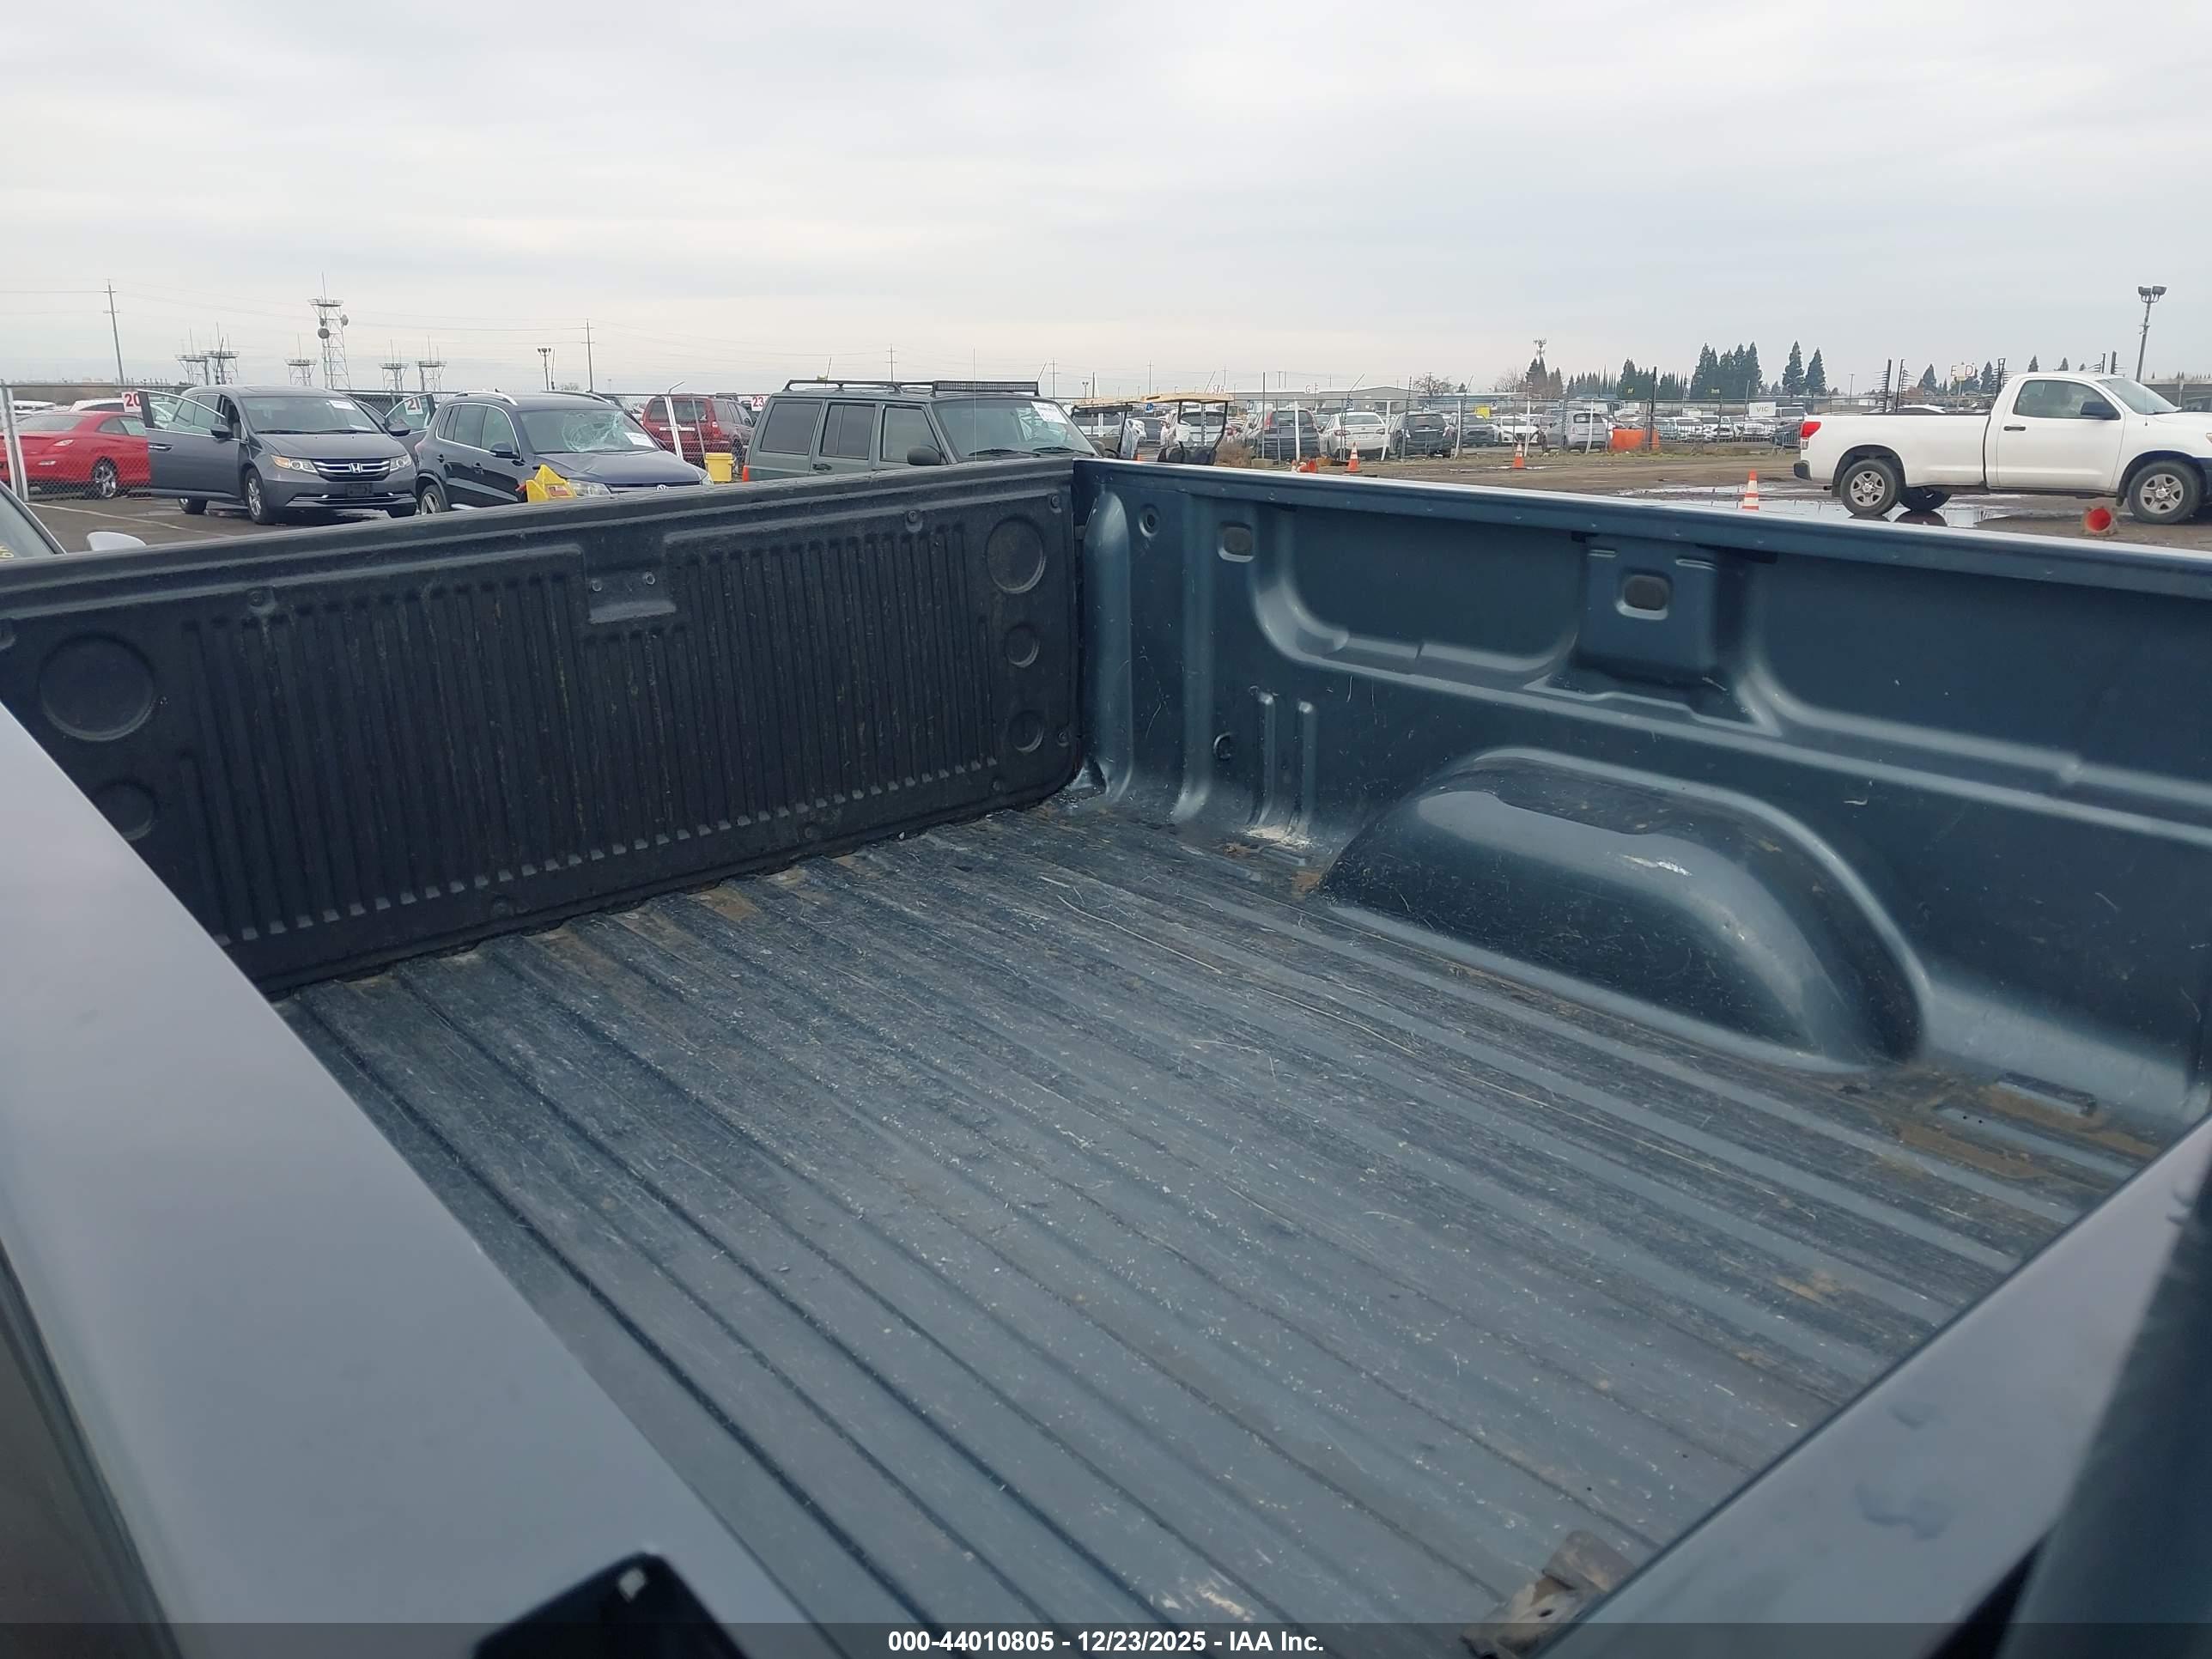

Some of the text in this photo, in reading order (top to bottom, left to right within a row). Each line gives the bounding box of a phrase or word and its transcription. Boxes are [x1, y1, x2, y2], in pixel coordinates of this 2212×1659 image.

[1966, 365, 1973, 376] D
[125, 393, 141, 406] 20
[752, 397, 764, 407] 23
